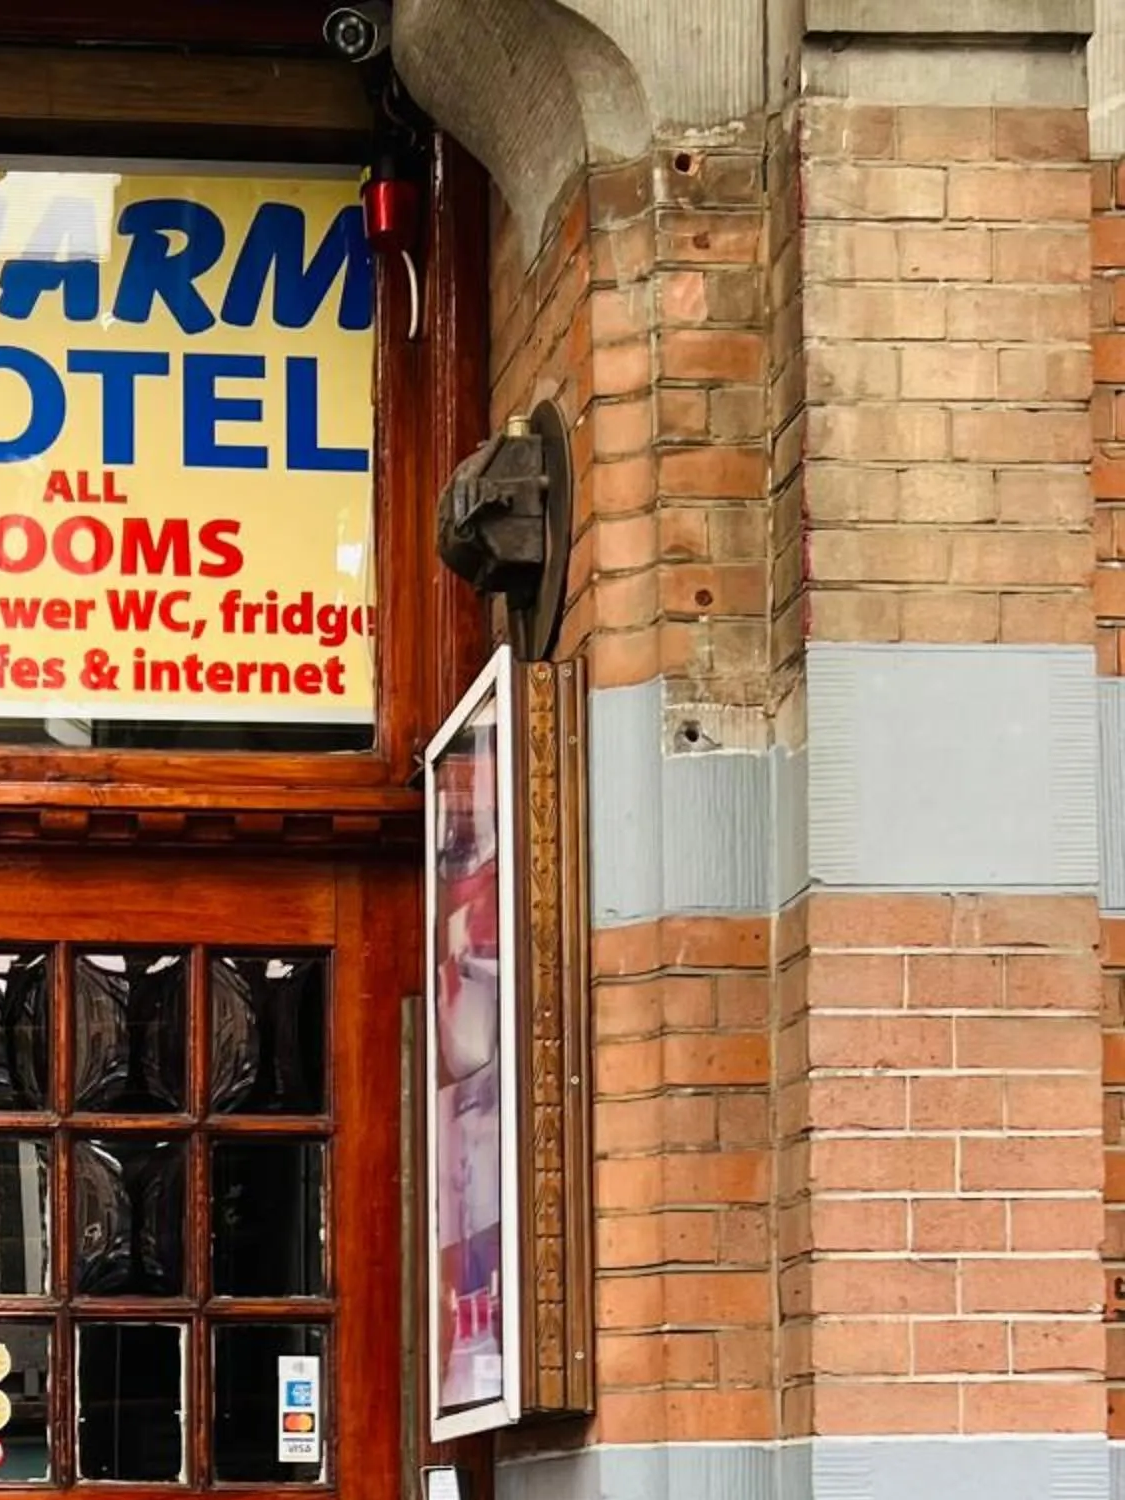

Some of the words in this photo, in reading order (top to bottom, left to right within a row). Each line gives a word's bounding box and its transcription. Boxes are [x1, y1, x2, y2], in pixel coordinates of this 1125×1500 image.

[43, 469, 128, 504] ALL
[105, 588, 207, 640] WC,
[79, 647, 120, 692] &
[133, 648, 346, 695] internet
